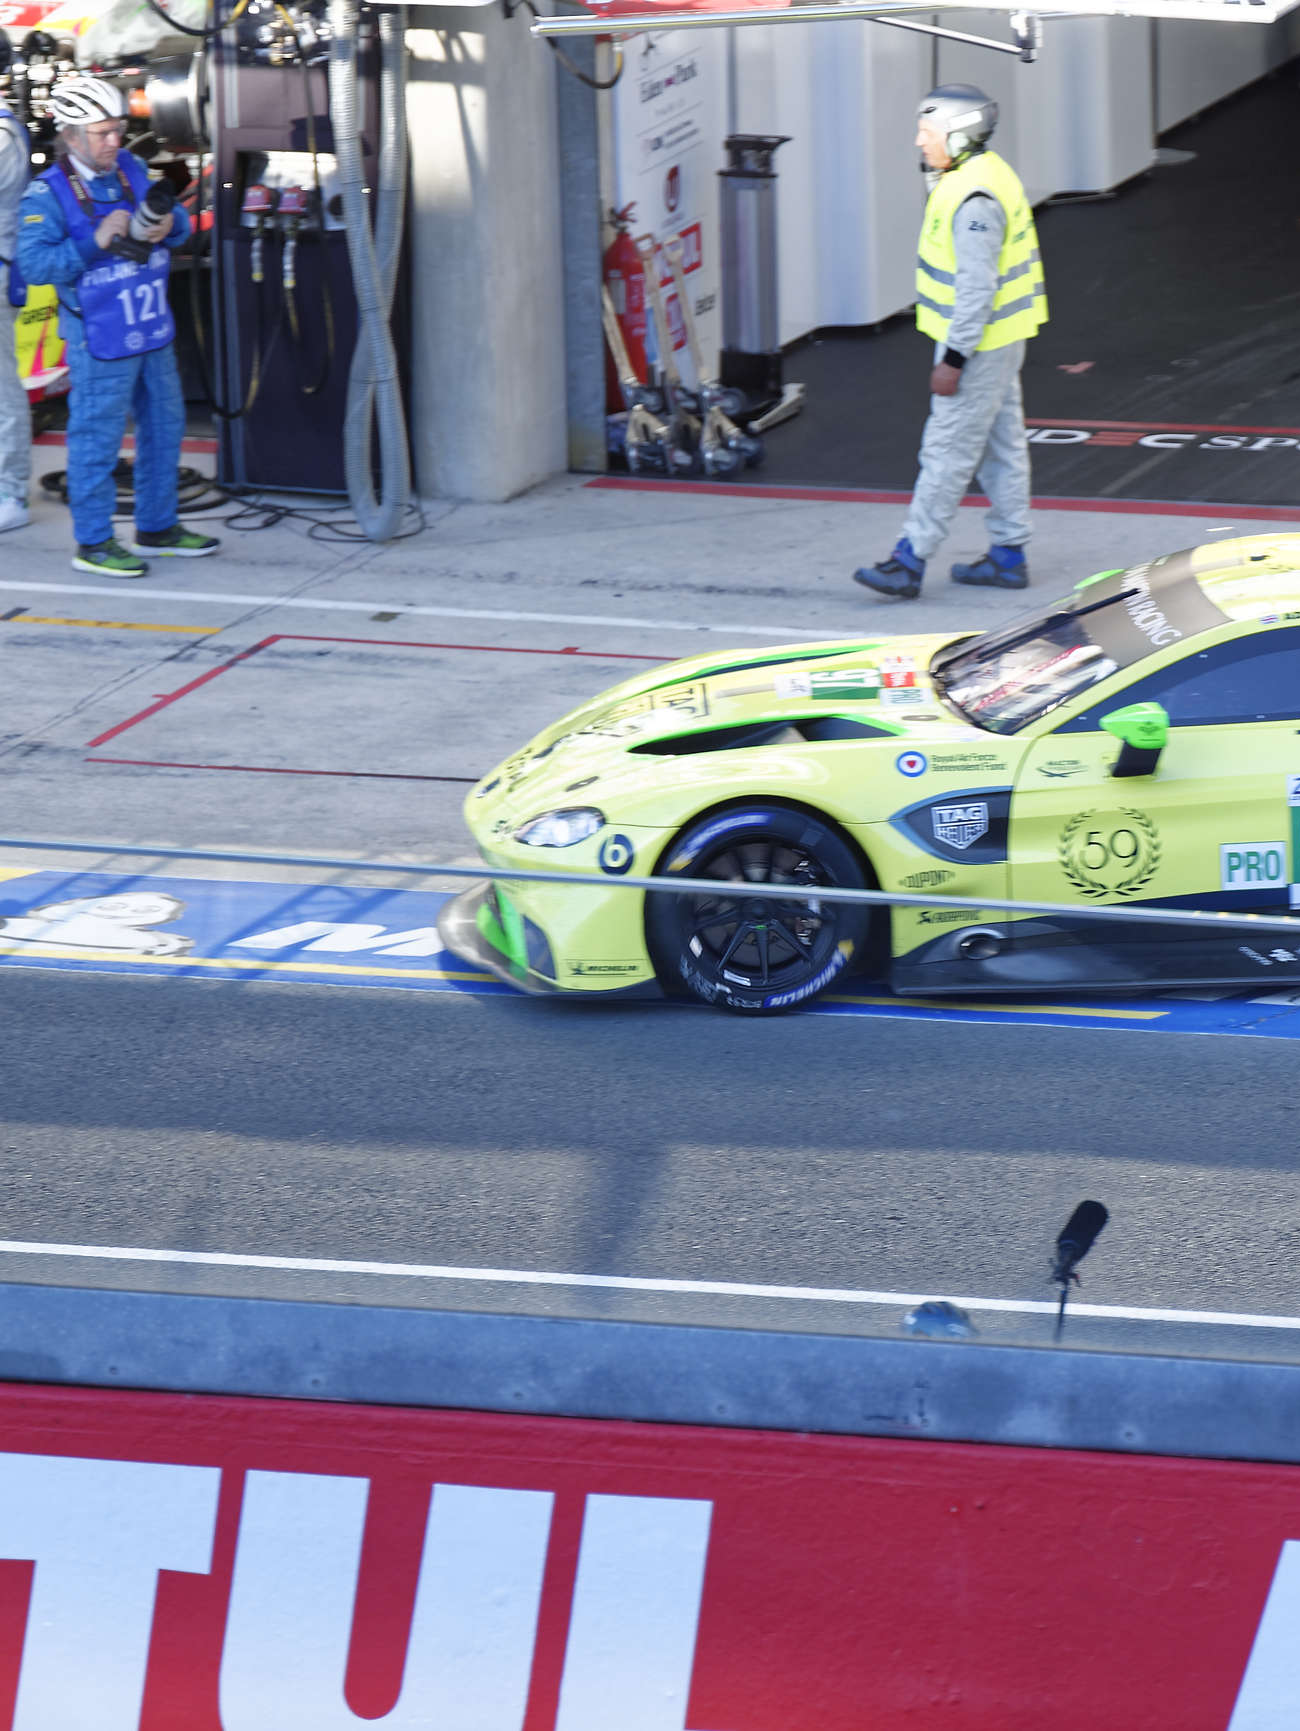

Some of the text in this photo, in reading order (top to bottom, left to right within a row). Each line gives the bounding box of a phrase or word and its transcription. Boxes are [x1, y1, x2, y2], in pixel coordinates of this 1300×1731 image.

[117, 279, 168, 325] 121
[936, 805, 984, 824] TAG
[1079, 829, 1139, 870] 59
[1226, 849, 1282, 883] PRO
